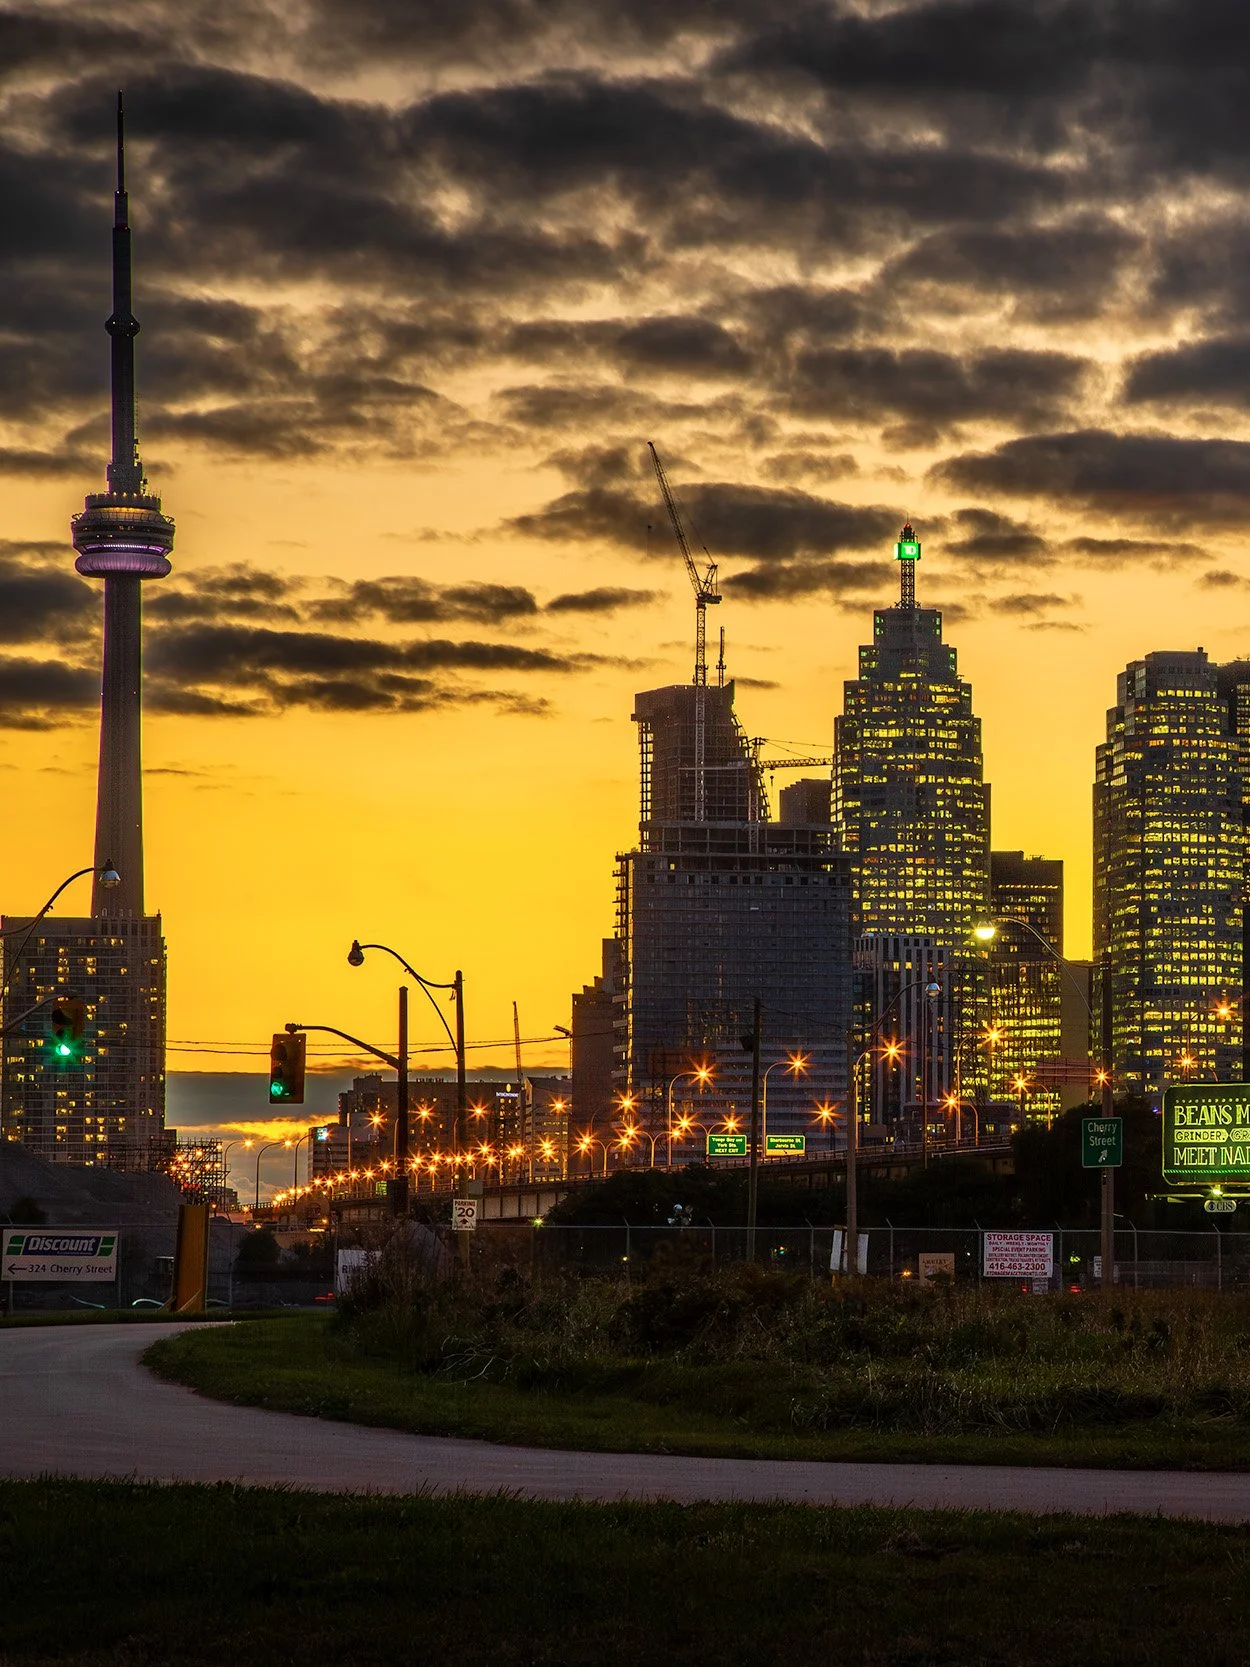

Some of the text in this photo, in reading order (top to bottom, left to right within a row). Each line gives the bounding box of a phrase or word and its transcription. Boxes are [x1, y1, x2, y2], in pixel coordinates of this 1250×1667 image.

[1174, 1105, 1232, 1126] BEANS
[1087, 1122, 1117, 1135] Cherry
[1089, 1136, 1116, 1146] Street
[1175, 1130, 1225, 1141] GRINDER.
[1173, 1147, 1217, 1166] MEET
[1216, 1201, 1233, 1211] CBS
[1025, 1234, 1051, 1242] SPACE
[28, 1237, 96, 1251] Discount
[28, 1264, 113, 1275] 324 Cherry Street
[988, 1262, 1046, 1271] 416-463-2300
